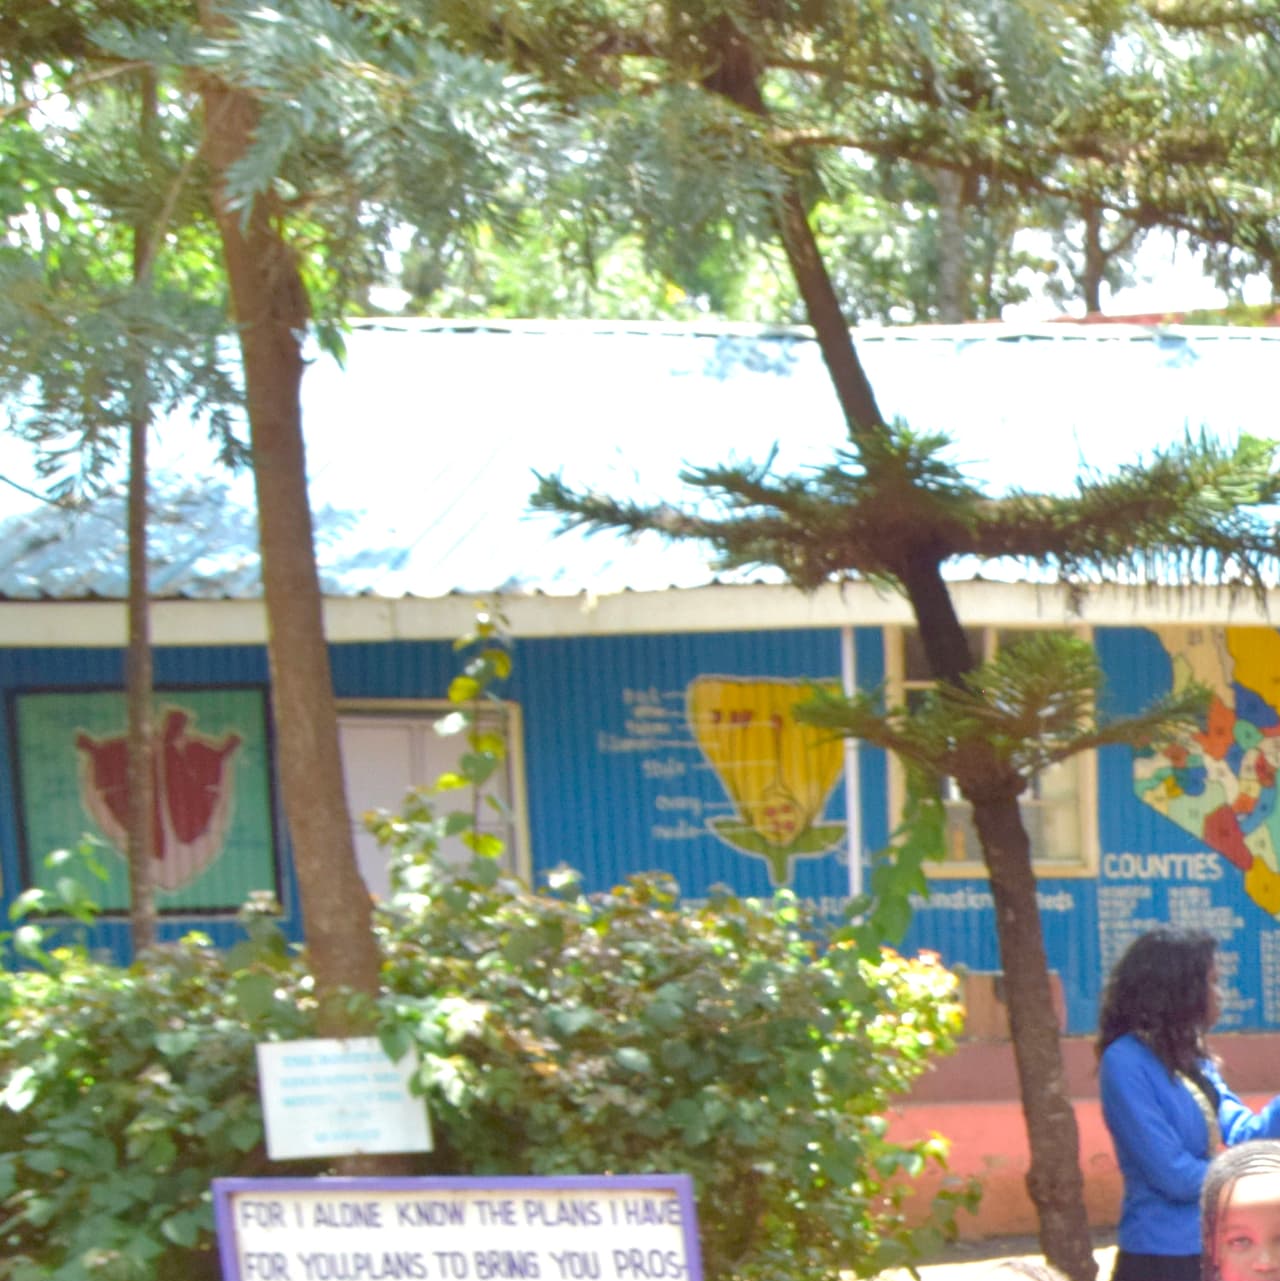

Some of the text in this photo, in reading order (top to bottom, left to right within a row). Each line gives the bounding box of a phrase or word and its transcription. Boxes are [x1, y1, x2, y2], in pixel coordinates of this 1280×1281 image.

[1104, 853, 1223, 881] COUNTIES
[240, 1198, 682, 1229] FOR I ALONE KNOW THE PLANS I HAVE
[245, 1252, 292, 1281] FOR
[432, 1250, 470, 1280] TO
[473, 1249, 541, 1280] BRING
[548, 1249, 602, 1280] YOU
